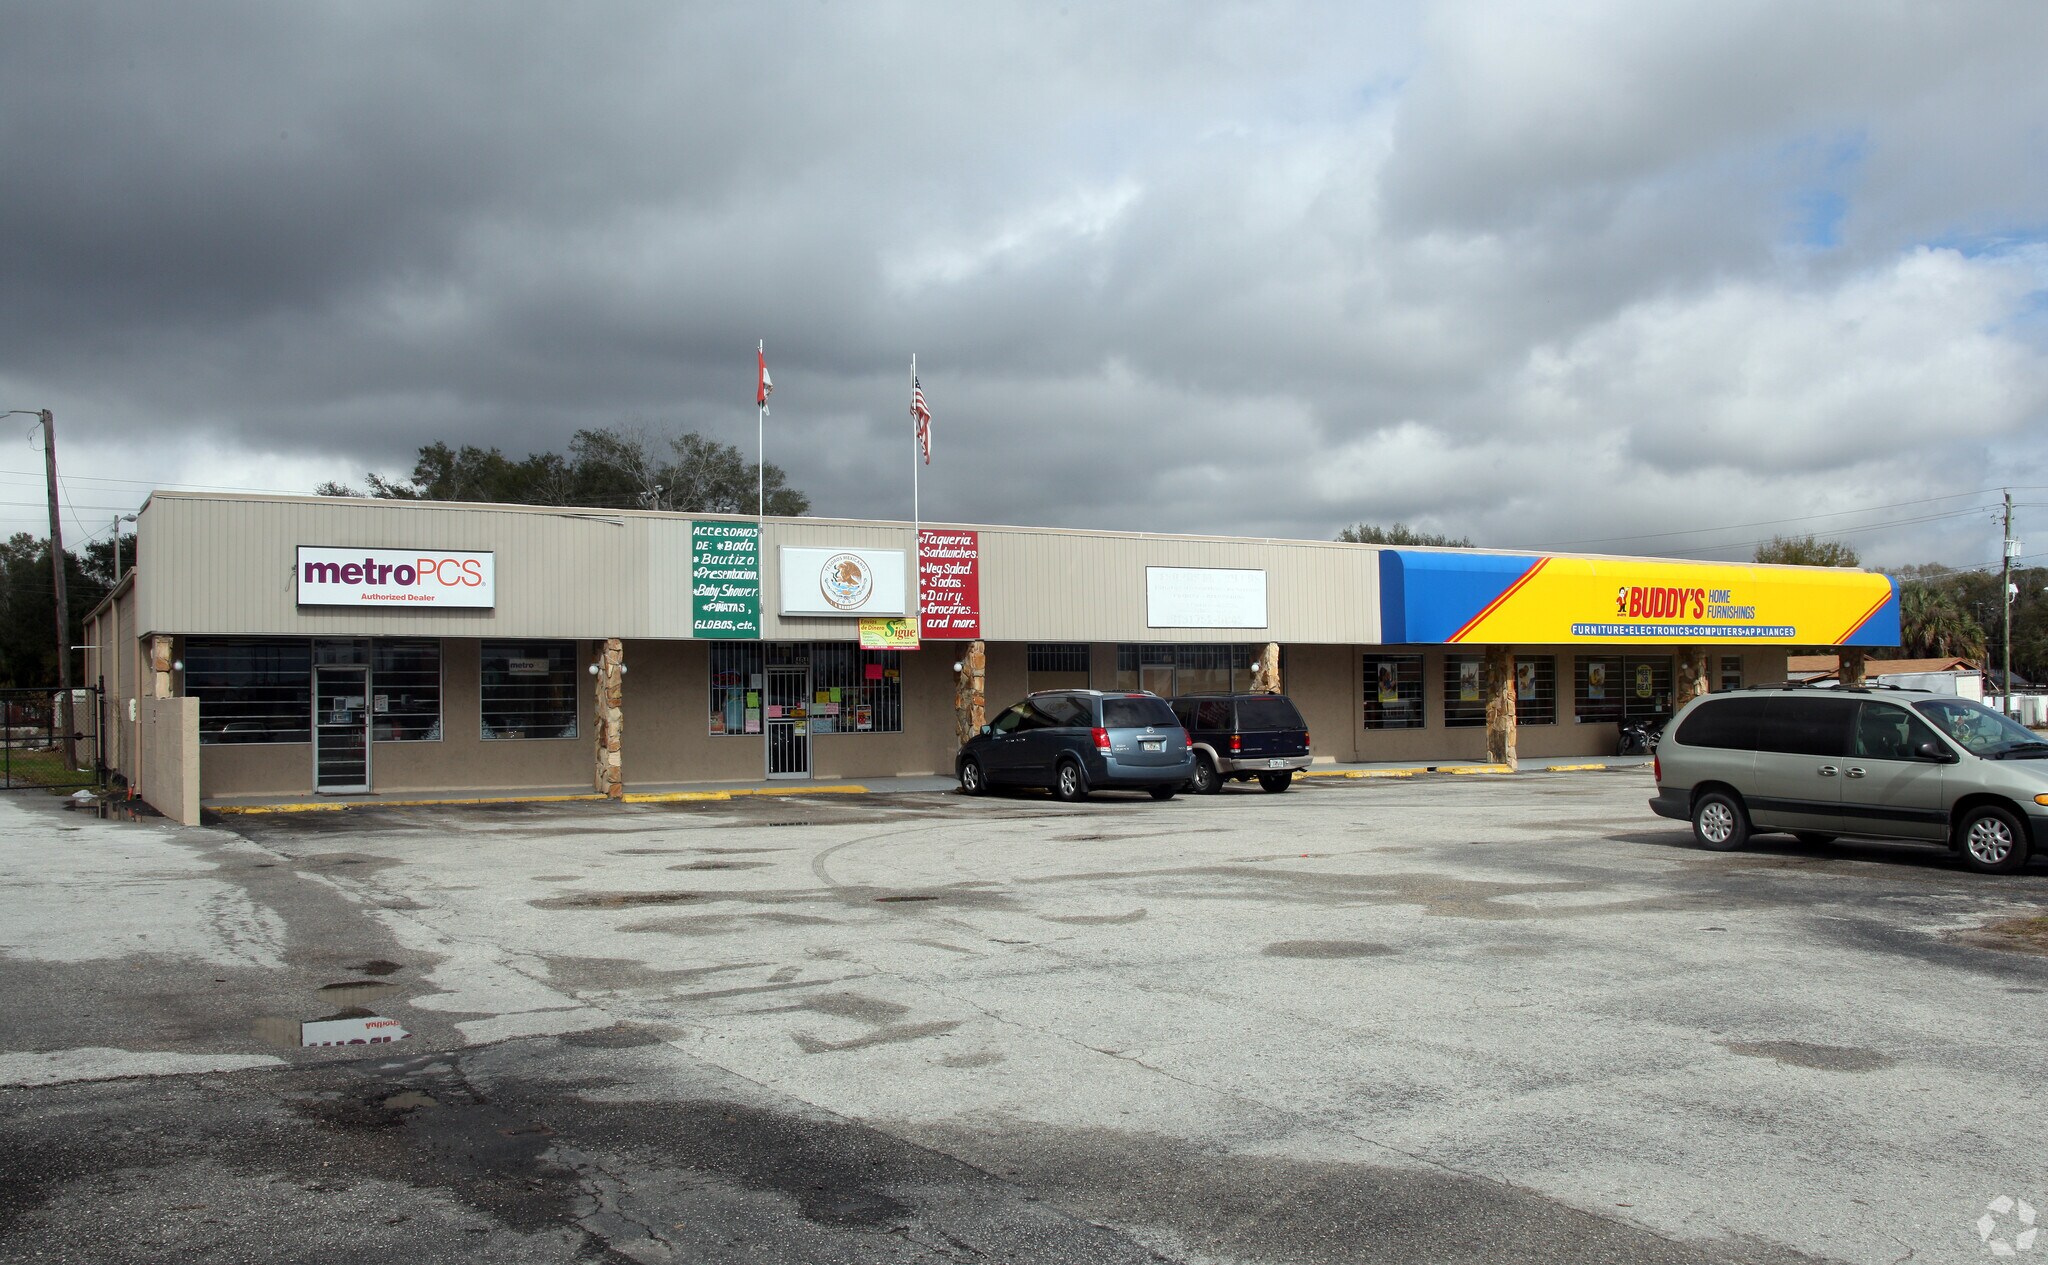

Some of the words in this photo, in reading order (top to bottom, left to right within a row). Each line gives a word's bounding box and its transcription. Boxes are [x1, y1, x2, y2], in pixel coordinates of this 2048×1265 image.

[361, 593, 406, 601] Authorized
[408, 594, 435, 602] Dealer
[697, 584, 720, 601] Baby
[1708, 589, 1731, 604] HOME
[1629, 586, 1705, 619] BUDDY'S
[1707, 605, 1756, 619] FURNISHINGS
[926, 615, 950, 628] and
[884, 620, 916, 640] Sigue
[1572, 626, 1625, 635] FURNITURE
[1629, 626, 1690, 636] ELECTRONICS
[1693, 627, 1742, 636] COMPUTERS
[1745, 628, 1795, 636] APPLIANCES
